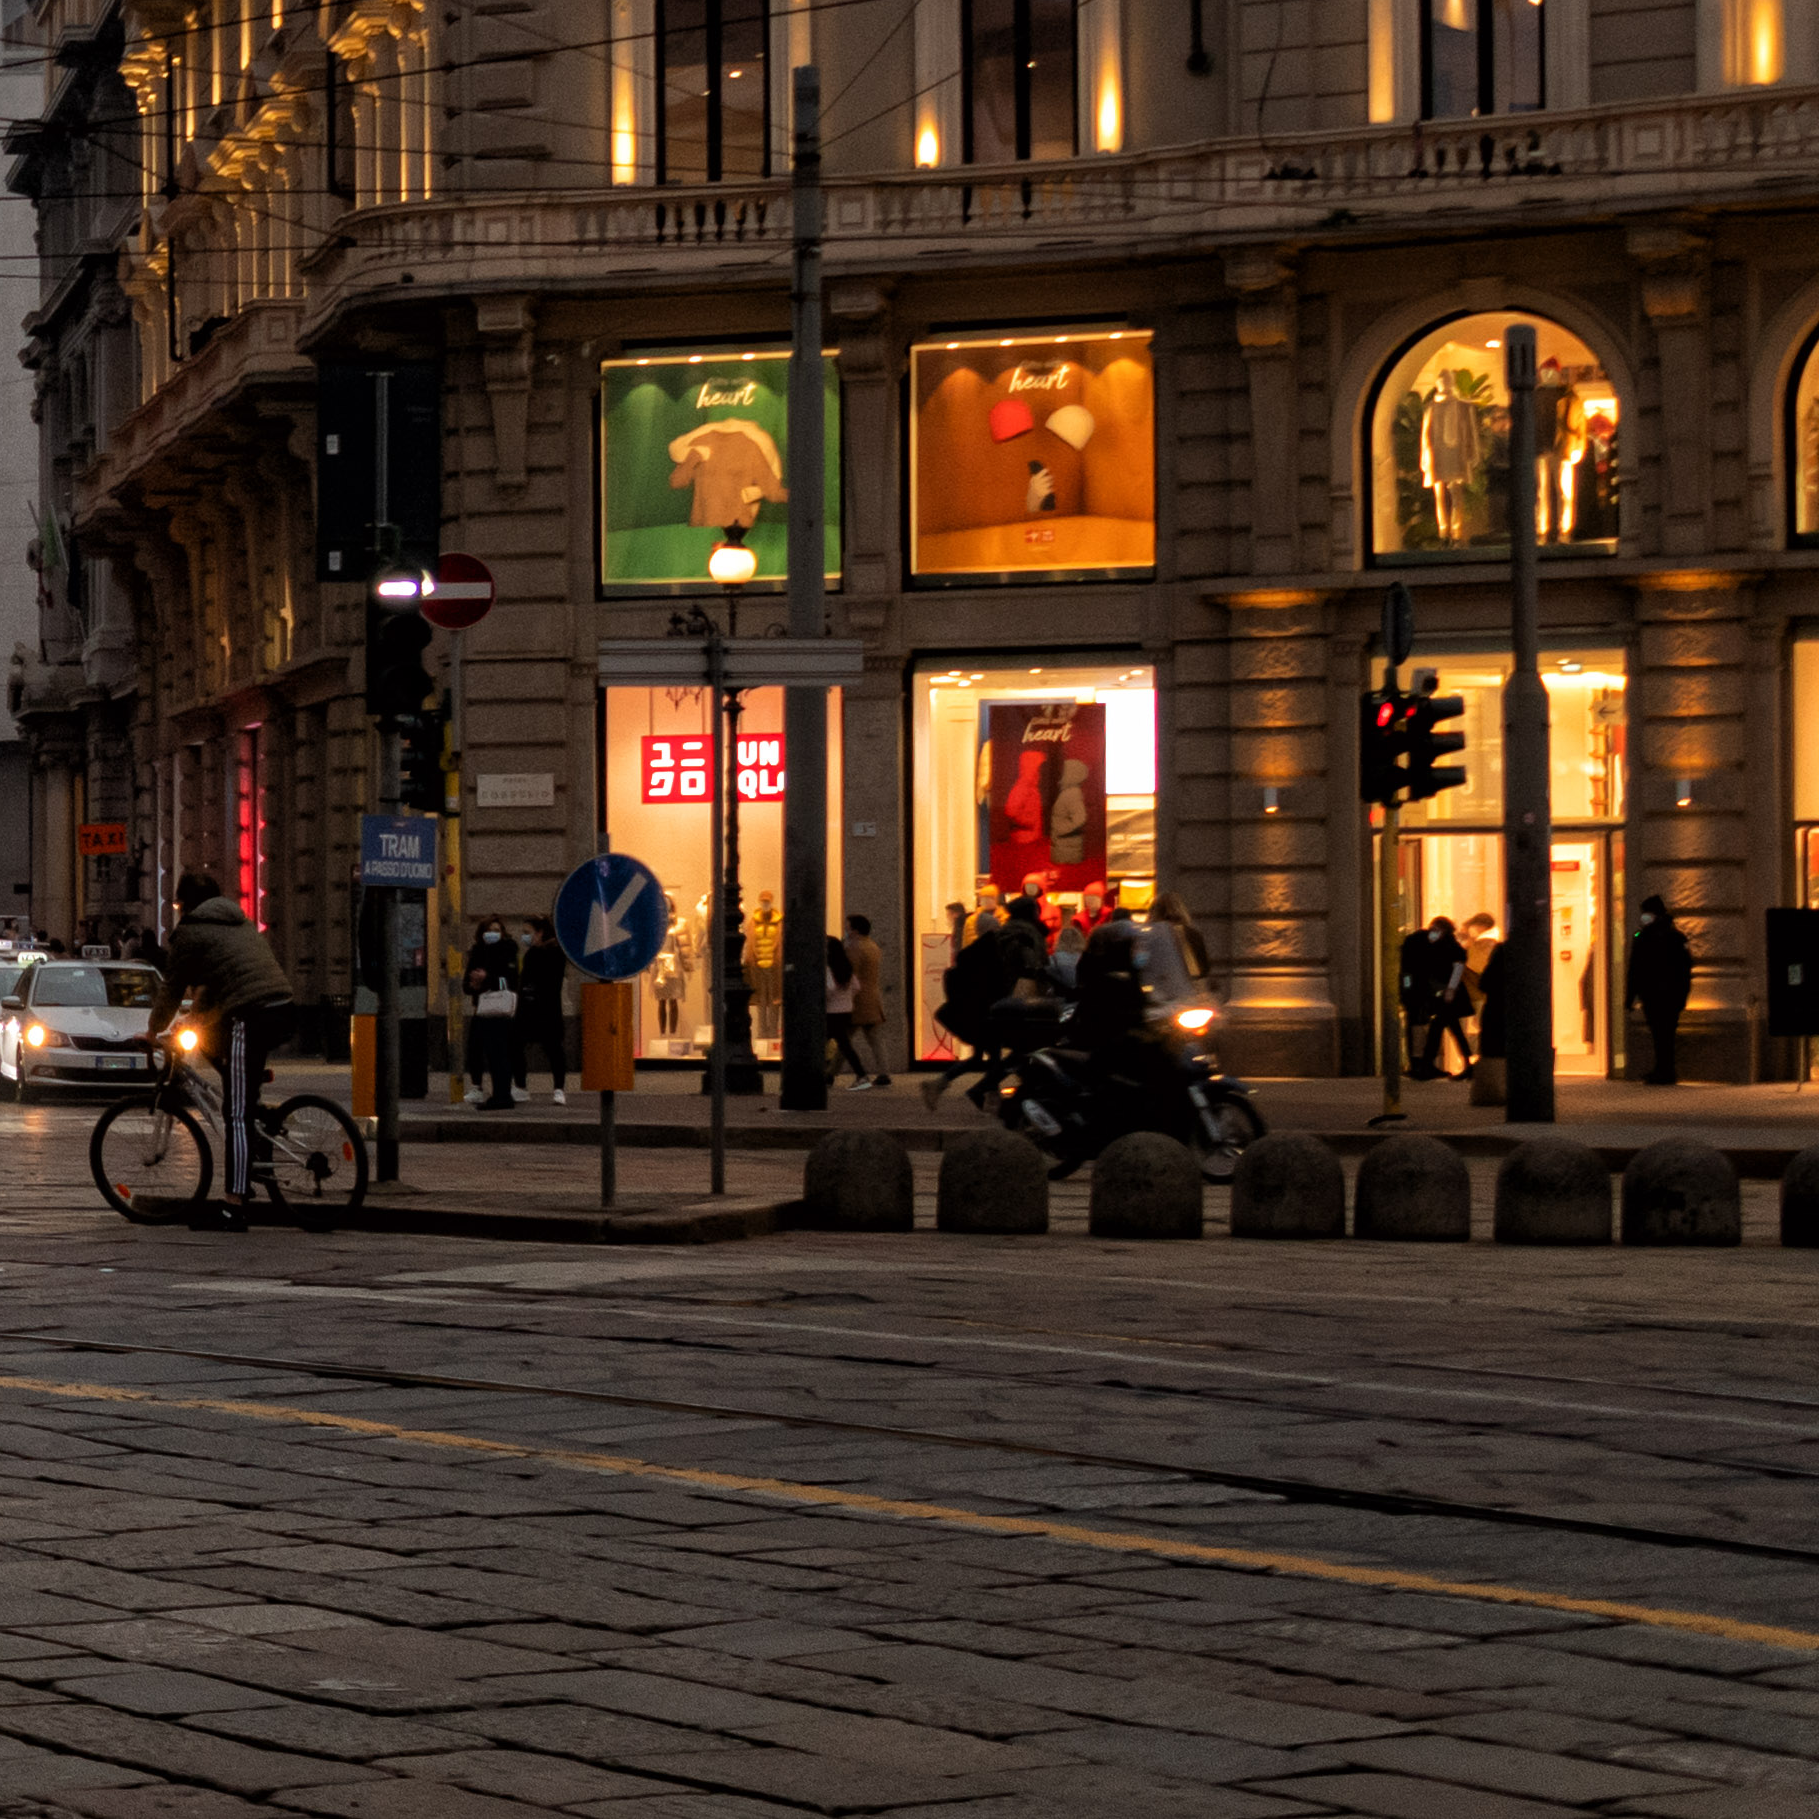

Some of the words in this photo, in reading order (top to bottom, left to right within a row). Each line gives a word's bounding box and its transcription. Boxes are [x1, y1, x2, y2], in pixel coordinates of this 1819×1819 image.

[1009, 365, 1070, 393] heart
[696, 381, 757, 409] heart
[1022, 721, 1073, 743] heart
[649, 741, 706, 768] ユニ
[737, 740, 779, 767] UN
[648, 770, 706, 797] クロ
[81, 832, 124, 848] TAXI
[378, 833, 420, 859] TRAM
